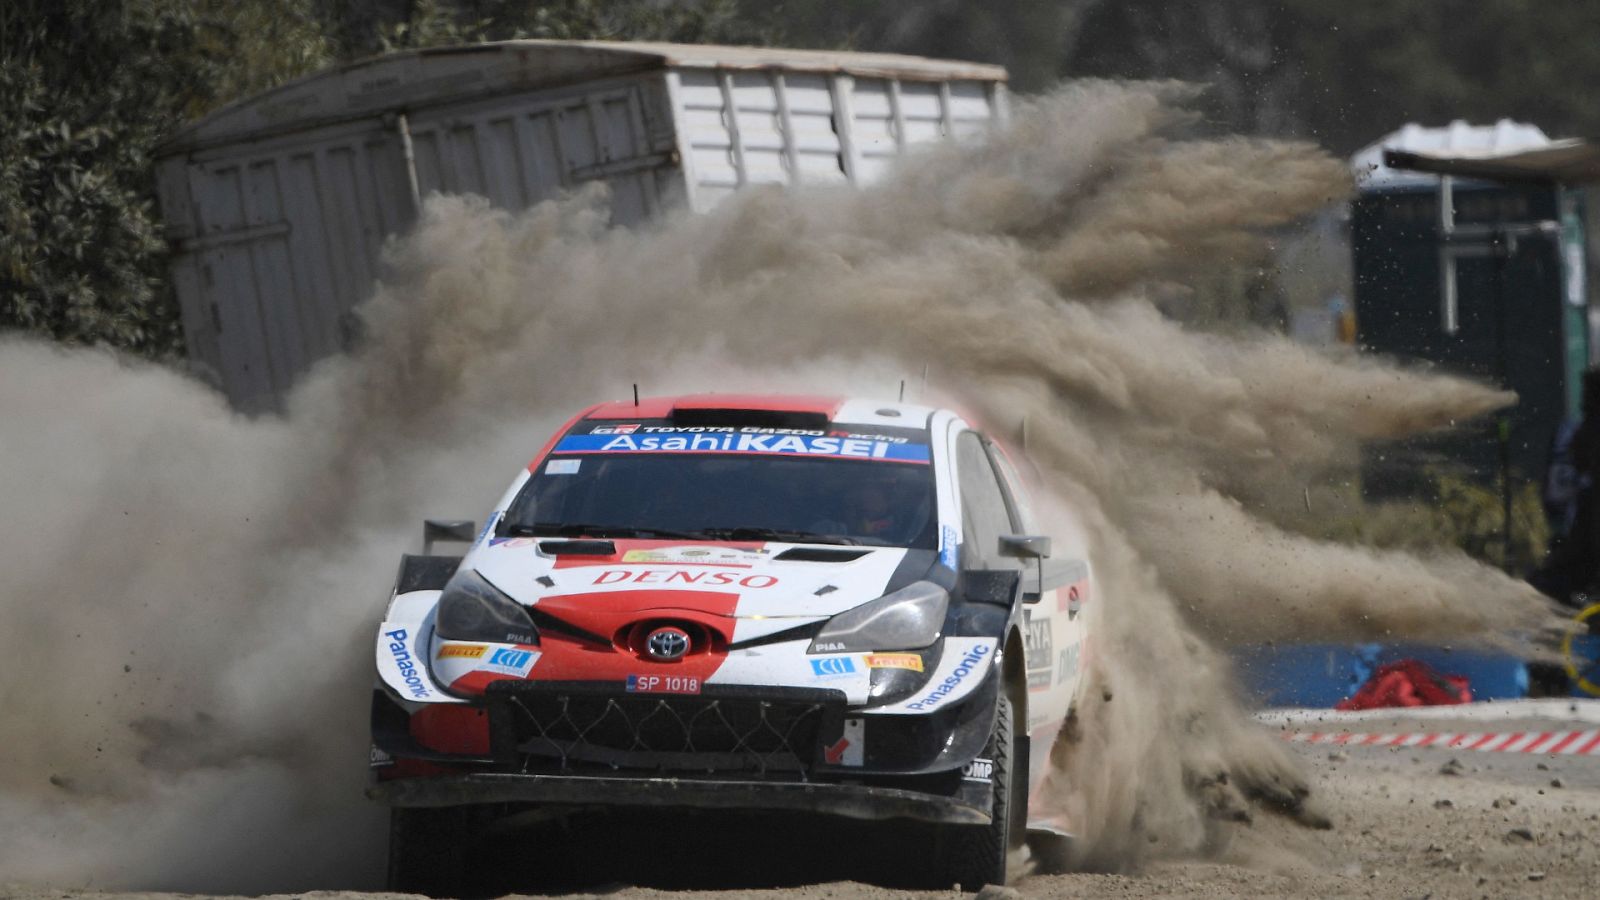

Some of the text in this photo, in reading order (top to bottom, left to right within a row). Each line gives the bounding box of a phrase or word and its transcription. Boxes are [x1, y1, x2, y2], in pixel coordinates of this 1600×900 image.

[740, 426, 825, 437] GAZOO
[829, 429, 909, 444] Racing
[591, 570, 779, 588] DENSO
[506, 633, 532, 644] PIAA
[814, 641, 847, 651] PIAA
[385, 628, 430, 698] Panasonic
[637, 676, 698, 692] SP 1018
[906, 644, 989, 711] Panasonic
[961, 761, 993, 778] OMP
